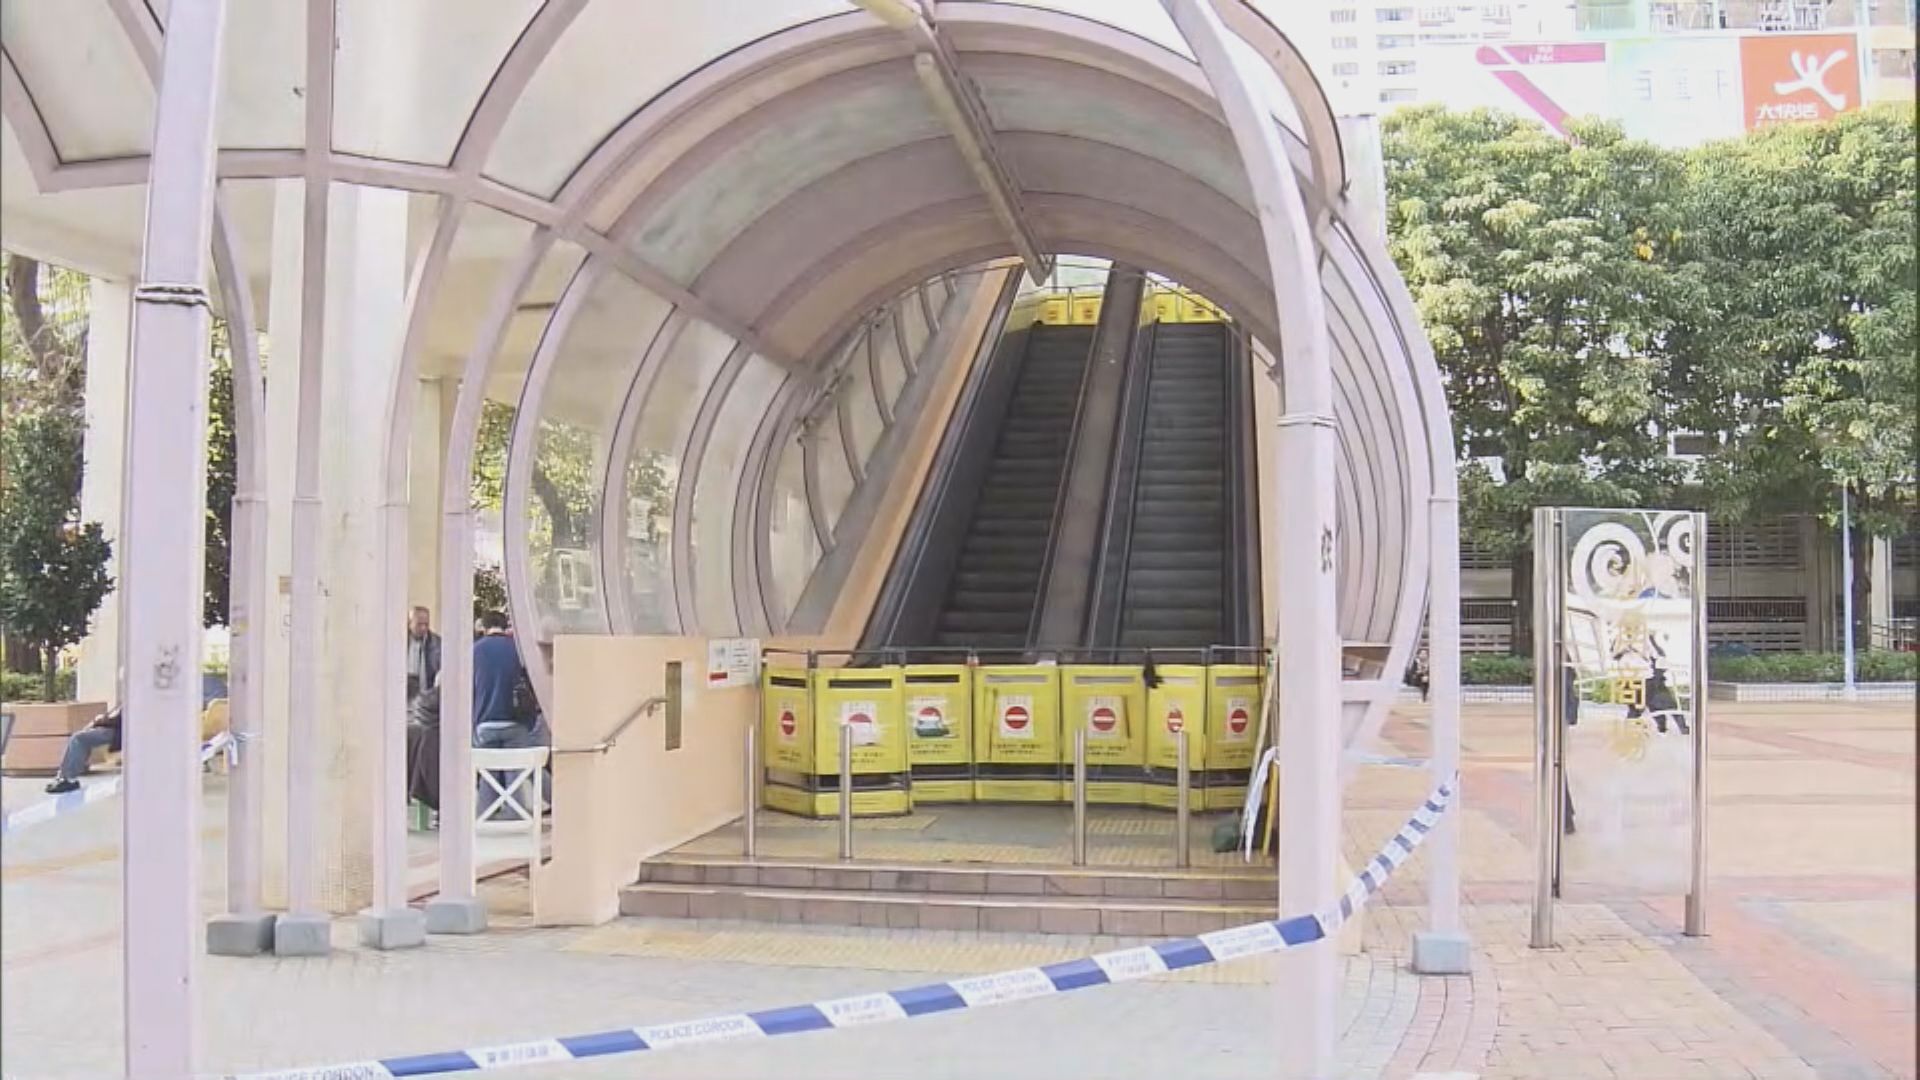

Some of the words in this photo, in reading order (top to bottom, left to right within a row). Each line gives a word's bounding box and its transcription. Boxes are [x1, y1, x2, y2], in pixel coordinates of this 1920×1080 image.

[1755, 102, 1818, 119] 大快活
[650, 1024, 692, 1040] POLICE
[694, 1018, 744, 1035] CORDON
